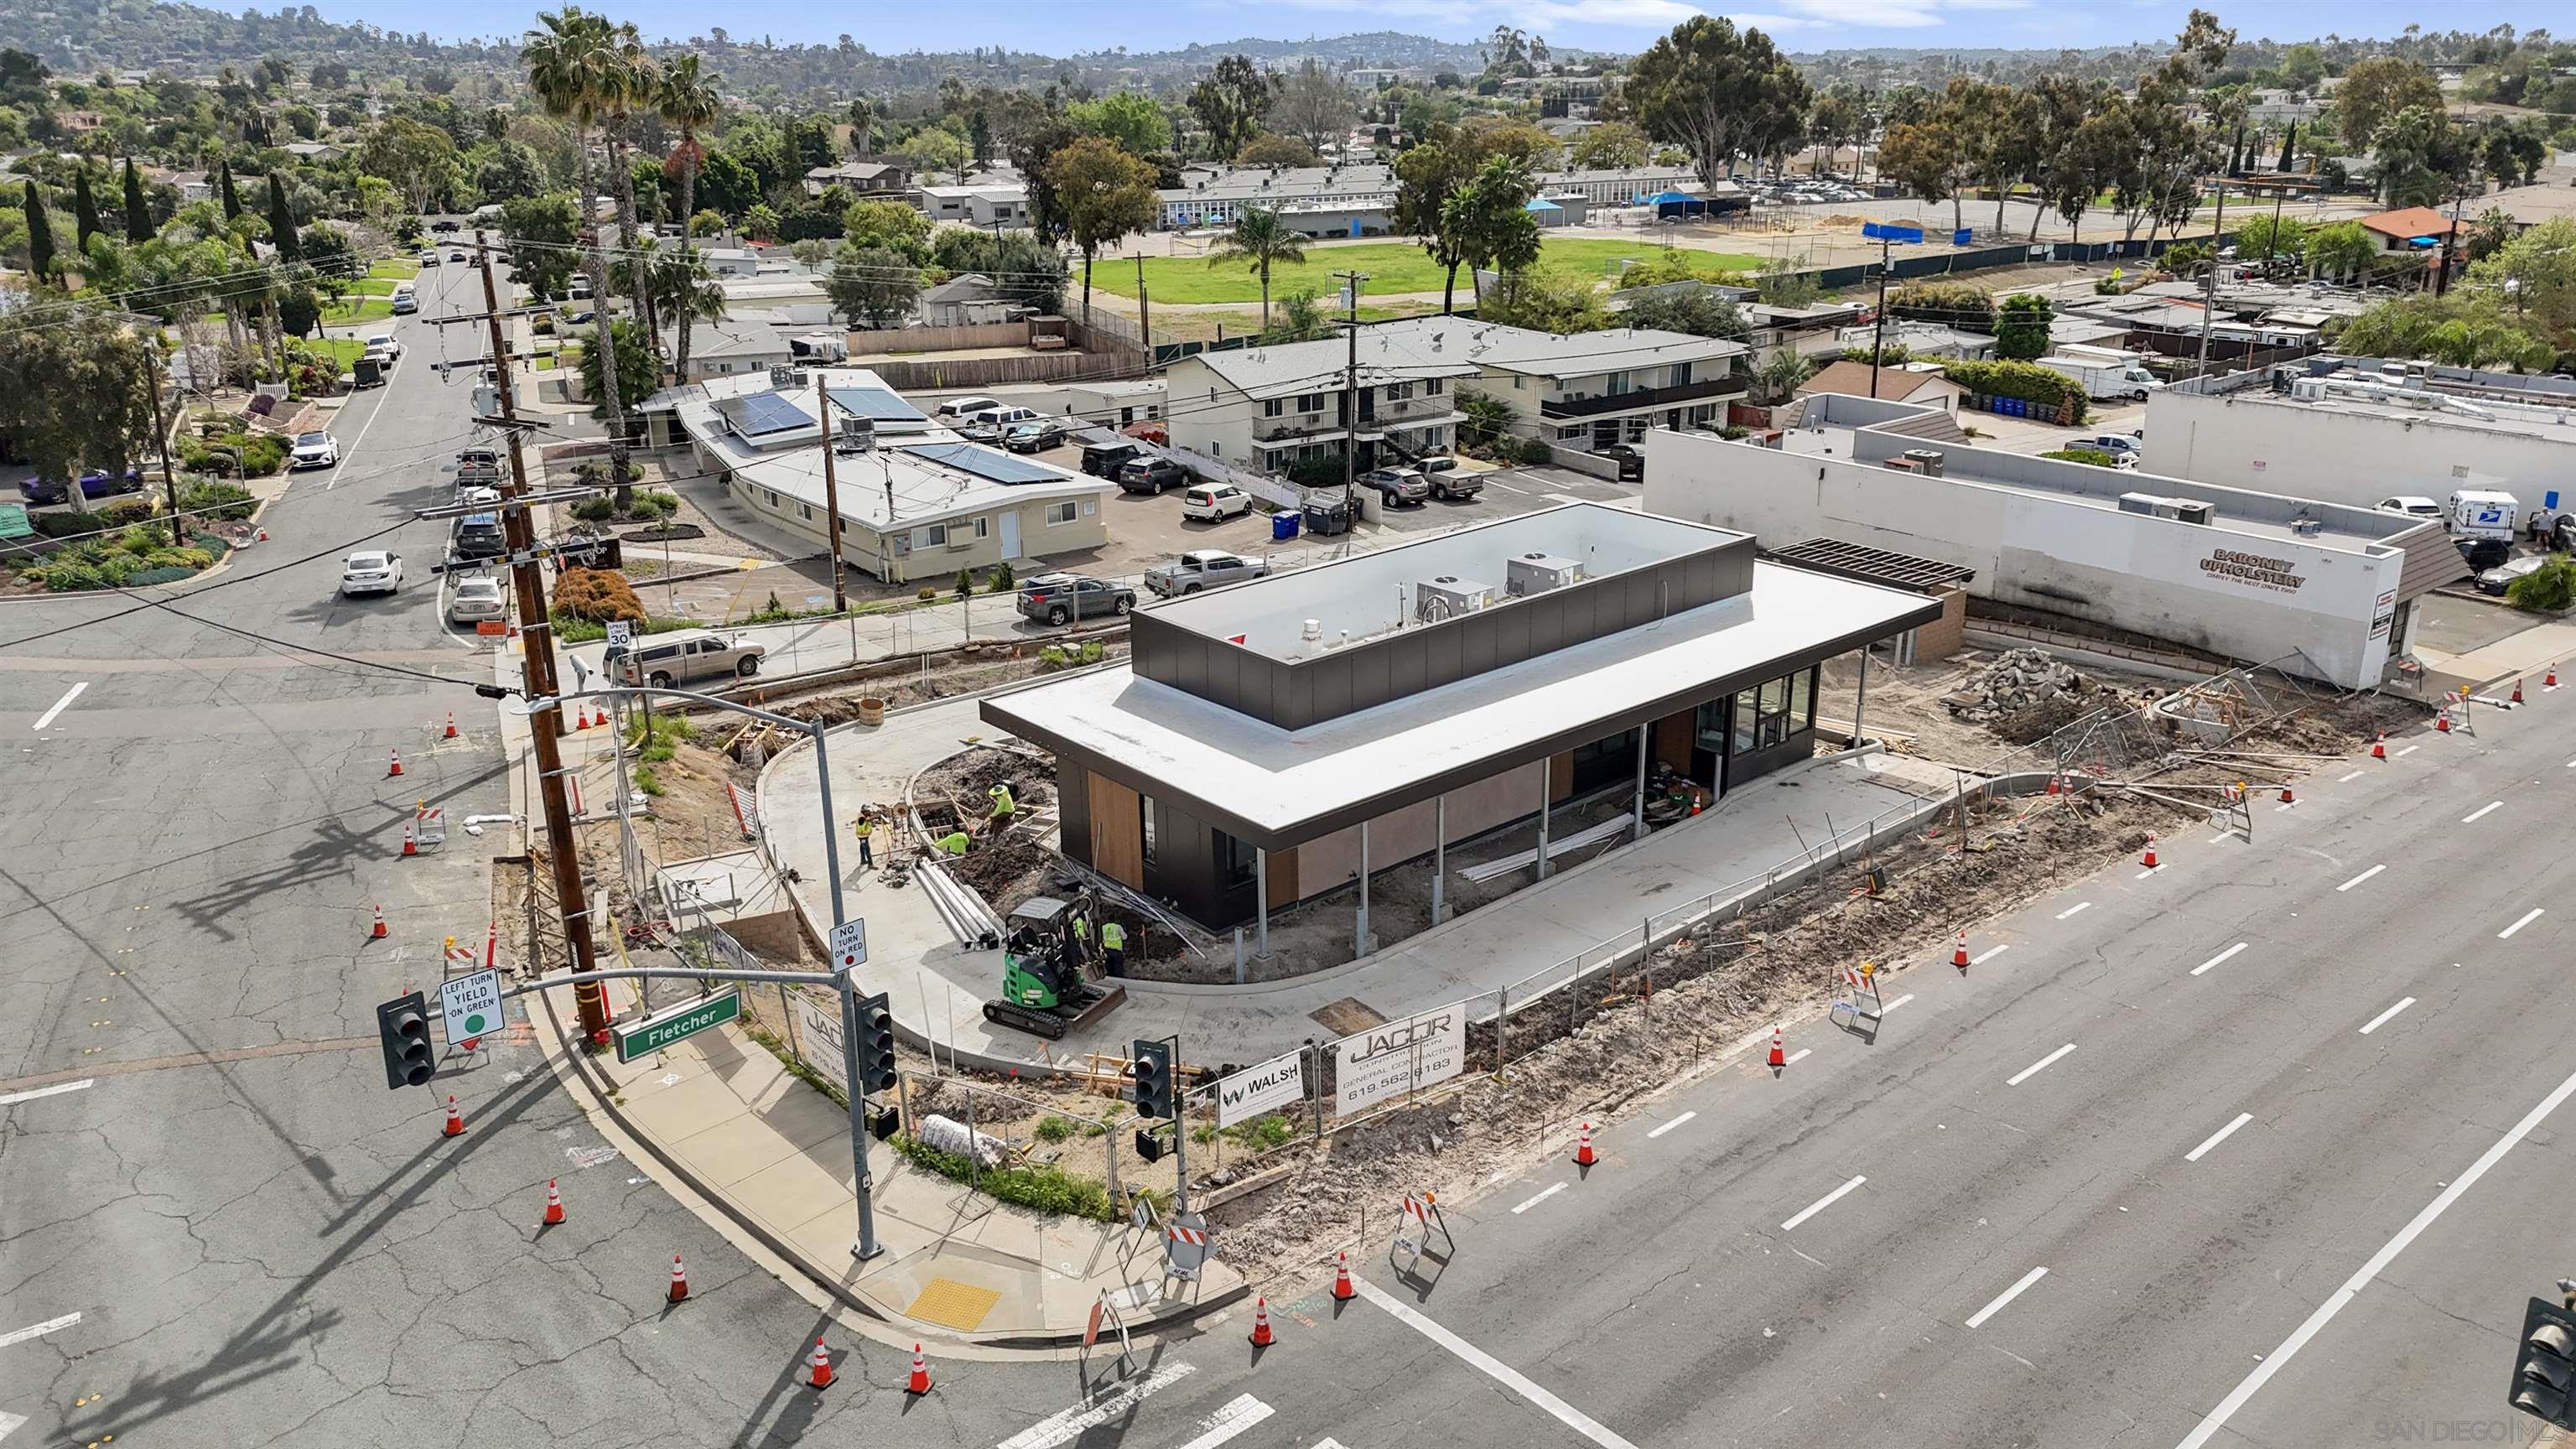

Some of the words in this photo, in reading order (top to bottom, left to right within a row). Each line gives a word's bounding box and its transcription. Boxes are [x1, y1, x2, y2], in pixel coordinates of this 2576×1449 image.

[2214, 548, 2295, 574] BARONET
[2199, 558, 2306, 589] UPHOLSTERY
[2231, 576, 2243, 584] THE
[2244, 579, 2261, 588] BEST
[610, 634, 628, 645] 30
[839, 925, 854, 937] NO
[839, 934, 859, 948] TURN
[834, 949, 845, 958] ON
[848, 942, 863, 953] RED
[445, 981, 465, 995] LEFT
[470, 974, 493, 986] TURN
[454, 986, 487, 1005] YIELD
[450, 1007, 463, 1018] ON
[466, 997, 494, 1013] GREEN
[648, 1010, 717, 1046] Fletcher
[1350, 1013, 1452, 1064] JACOR
[1358, 1038, 1443, 1072] CONSTRUION
[1248, 1063, 1298, 1094] WALSH
[1343, 1067, 1388, 1089] GENERAL
